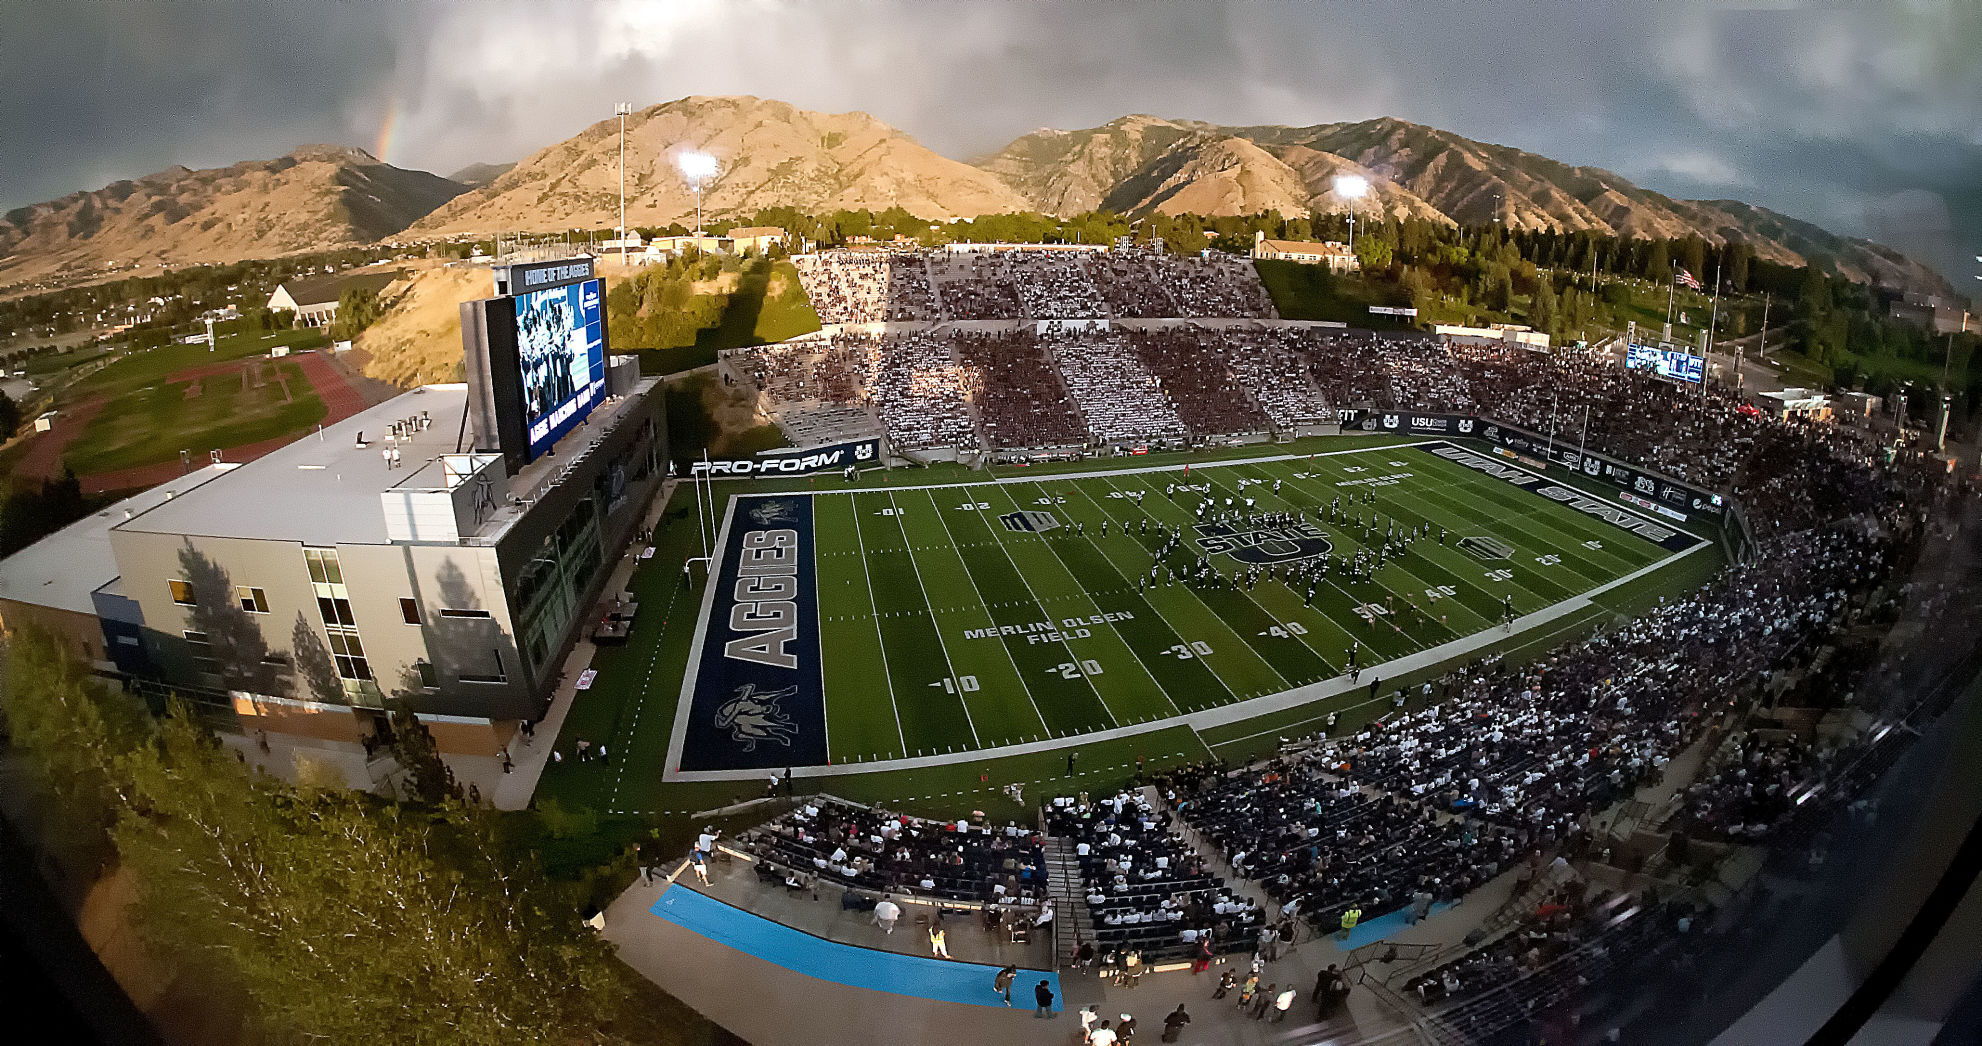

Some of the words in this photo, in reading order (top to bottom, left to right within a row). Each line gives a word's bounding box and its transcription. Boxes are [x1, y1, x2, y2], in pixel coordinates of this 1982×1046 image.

[525, 268, 547, 285] HOME
[548, 267, 556, 281] OF
[556, 265, 568, 280] THE
[569, 263, 589, 278] AGGIES
[1412, 417, 1432, 426] USU
[690, 451, 842, 475] PRO-FORM
[1432, 447, 1540, 485] UTAH
[1536, 486, 1677, 542] STATE
[1196, 522, 1331, 554] STATE
[1535, 554, 1561, 566] 20
[1484, 568, 1513, 582] 30
[724, 528, 798, 670] AGGIES
[1425, 585, 1456, 598] 40
[1352, 603, 1388, 619] 50
[963, 621, 1057, 640] MERLIN
[1061, 610, 1135, 628] OLSEN
[1270, 621, 1308, 639] 40
[1027, 628, 1092, 645] FIELD
[1171, 640, 1214, 660] 30
[1058, 659, 1104, 680] 20
[943, 675, 980, 694] 10
